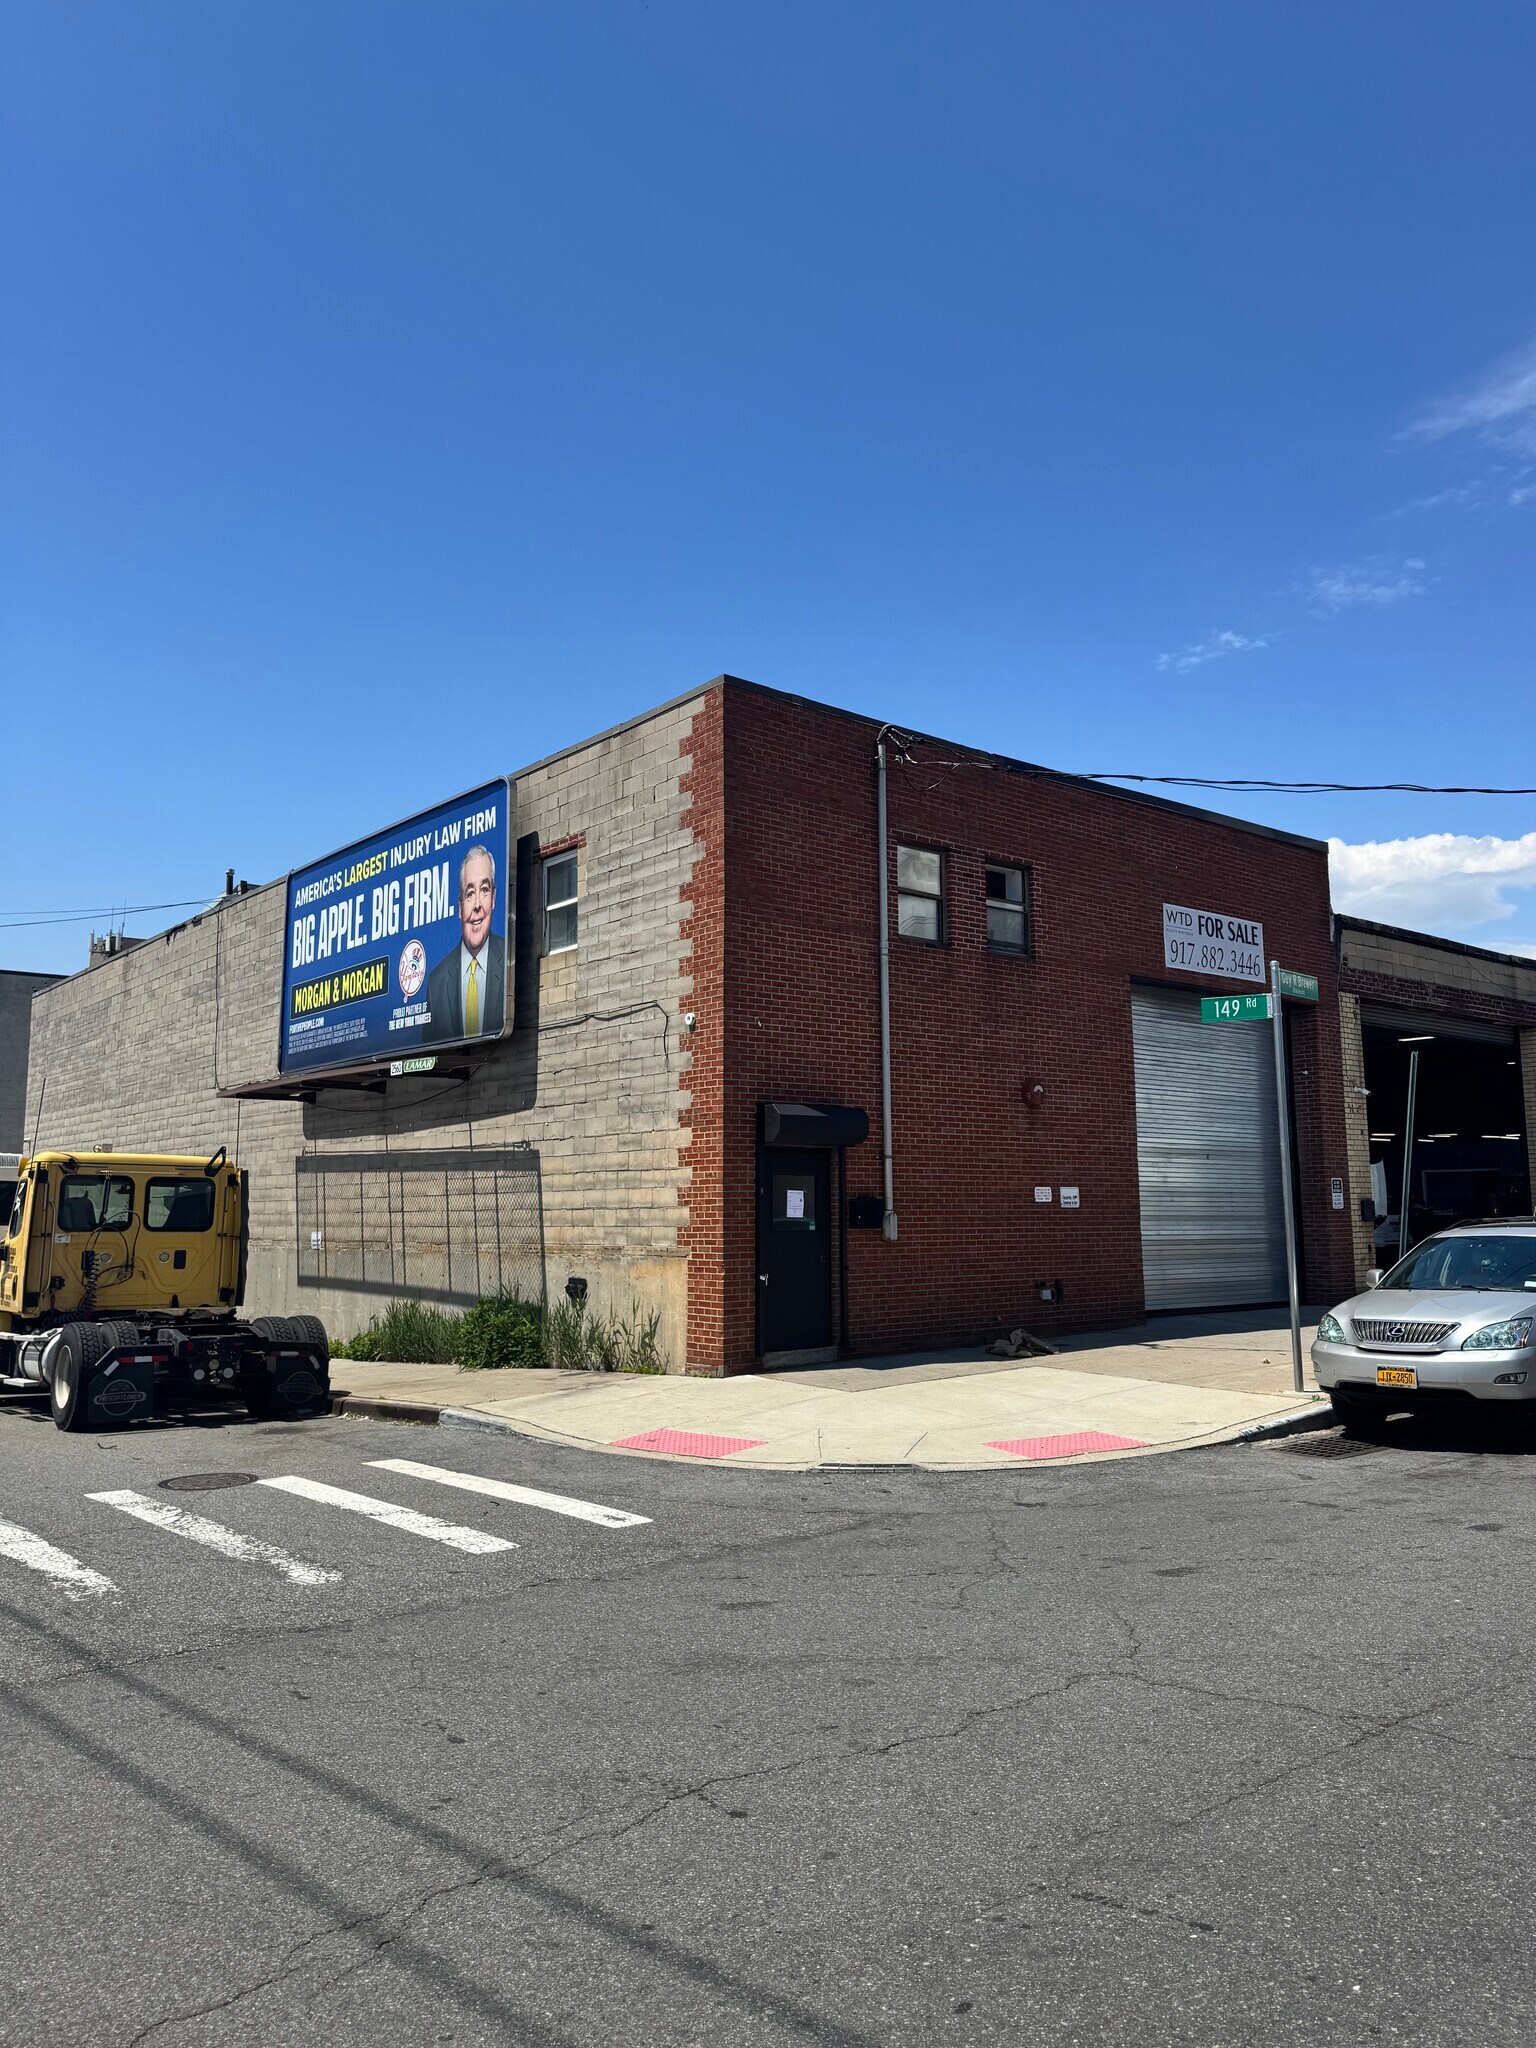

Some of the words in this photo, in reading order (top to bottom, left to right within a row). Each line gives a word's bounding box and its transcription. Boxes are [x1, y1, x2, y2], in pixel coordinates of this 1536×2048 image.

[294, 870, 343, 908] AMERICA'S
[344, 852, 388, 888] LARGEST
[390, 832, 432, 868] INJURY
[434, 820, 461, 849] LAW
[464, 805, 497, 840] FIRM
[292, 912, 316, 968] BIG
[317, 891, 367, 960] APPLE.
[371, 880, 400, 942] BIG
[403, 861, 455, 931] FIRM.
[1165, 908, 1193, 927] WTD
[1197, 914, 1225, 940] FOR
[1227, 921, 1260, 946] SALE
[1170, 939, 1262, 977] 917.882.3446
[294, 979, 332, 1014] MORGAN
[332, 980, 340, 1002] &
[342, 963, 384, 999] MORGAN
[1281, 972, 1292, 987] Guy
[1297, 976, 1315, 990] Brewer
[1214, 1000, 1240, 1018] 149
[1246, 997, 1257, 1008] Rd
[406, 1059, 432, 1070] LAMAR
[98, 1393, 142, 1403] FREIGHTLINER
